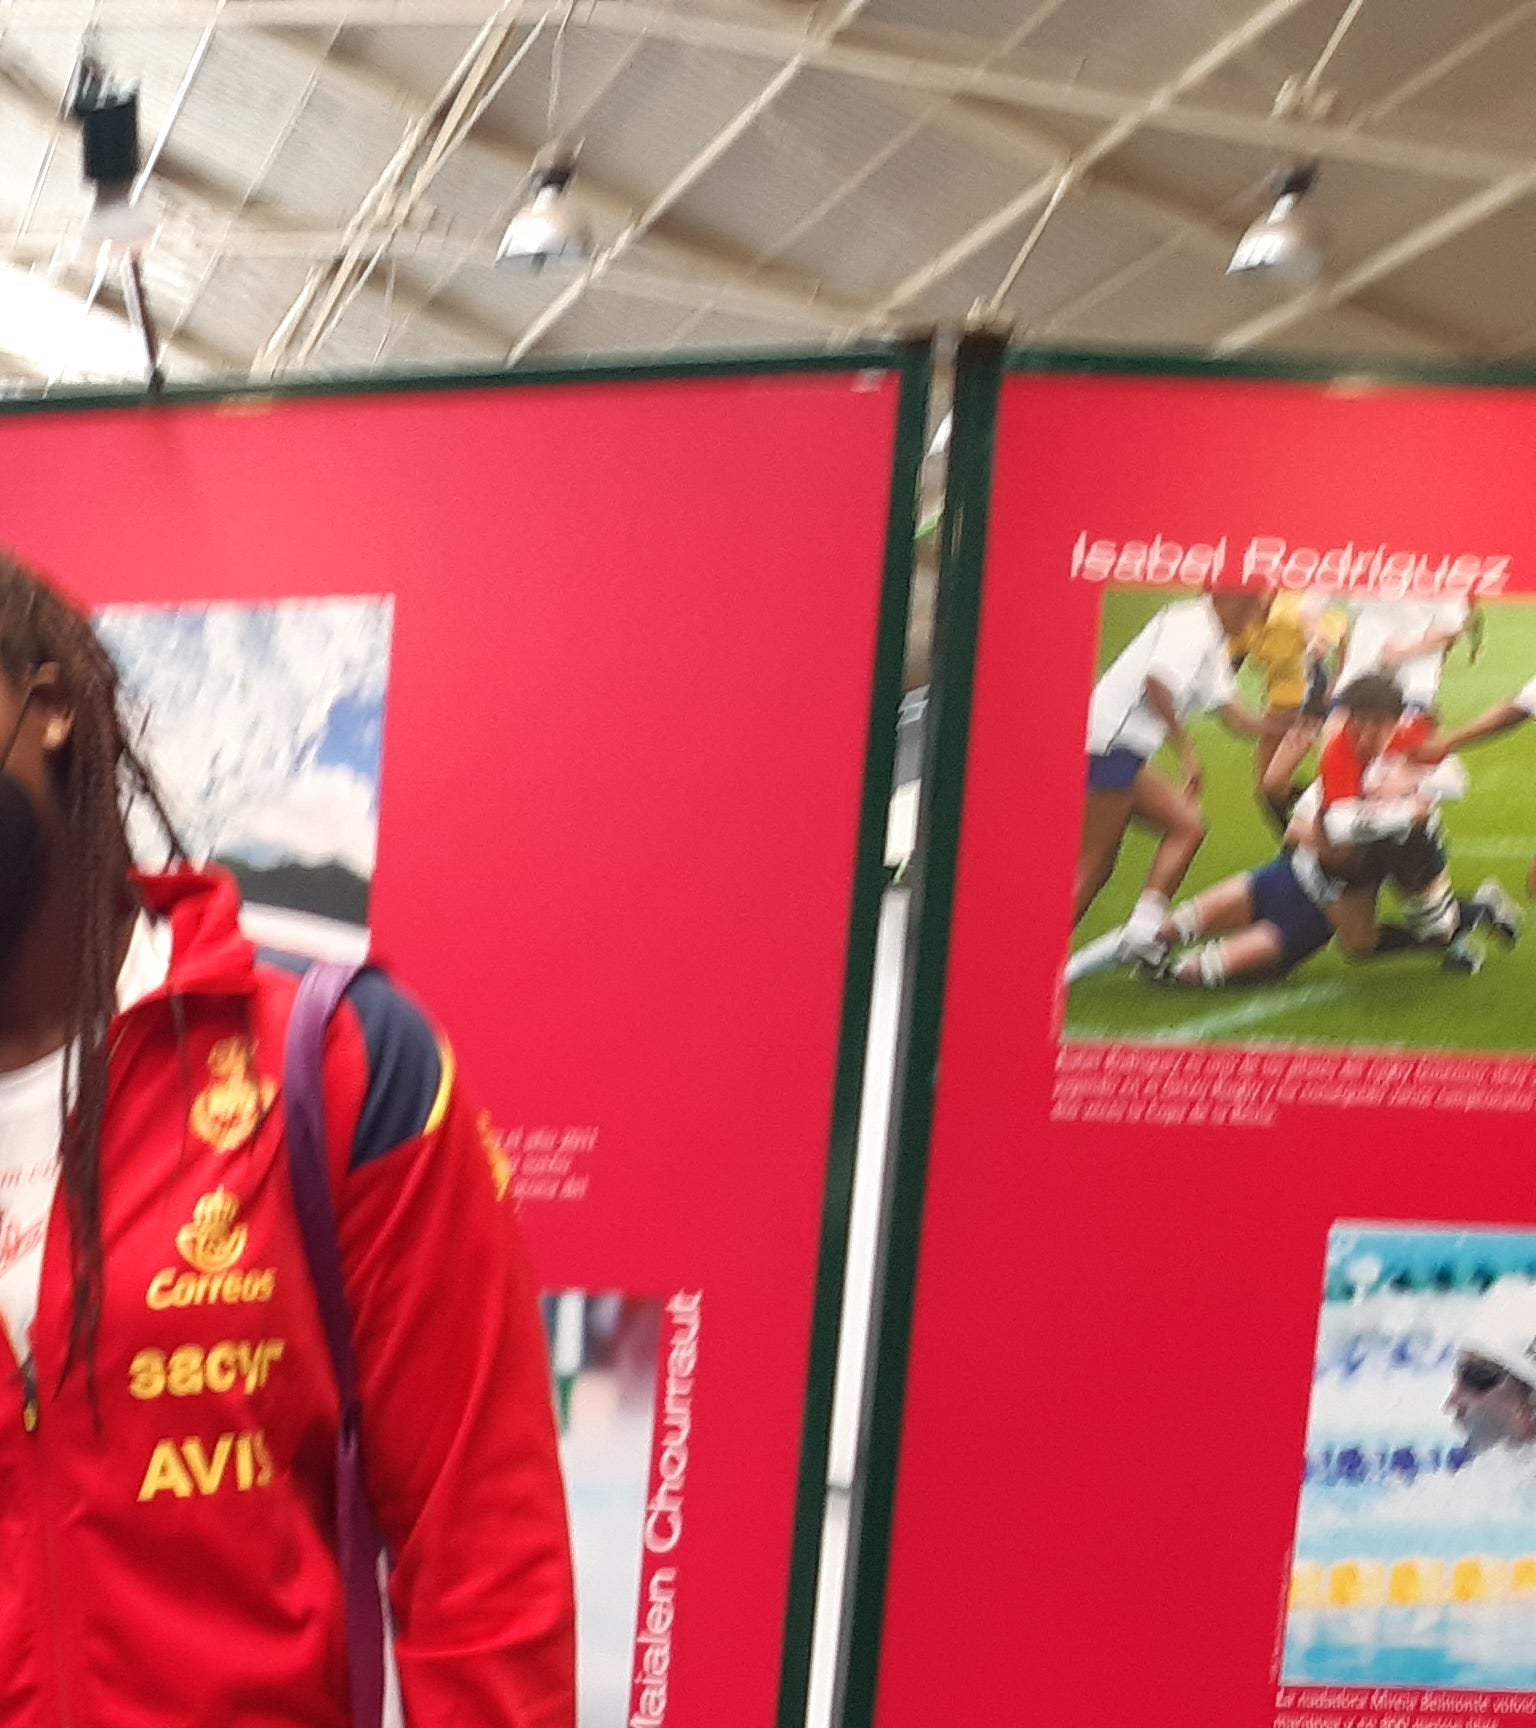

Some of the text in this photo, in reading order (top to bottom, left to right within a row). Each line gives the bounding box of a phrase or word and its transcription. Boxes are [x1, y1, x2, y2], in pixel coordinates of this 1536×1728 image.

[1069, 530, 1228, 583] Isabel
[145, 1266, 278, 1312] Correos
[642, 1287, 704, 1554] Chourraut
[1370, 1689, 1415, 1713] Mireia
[1419, 1691, 1489, 1714] Belmonte
